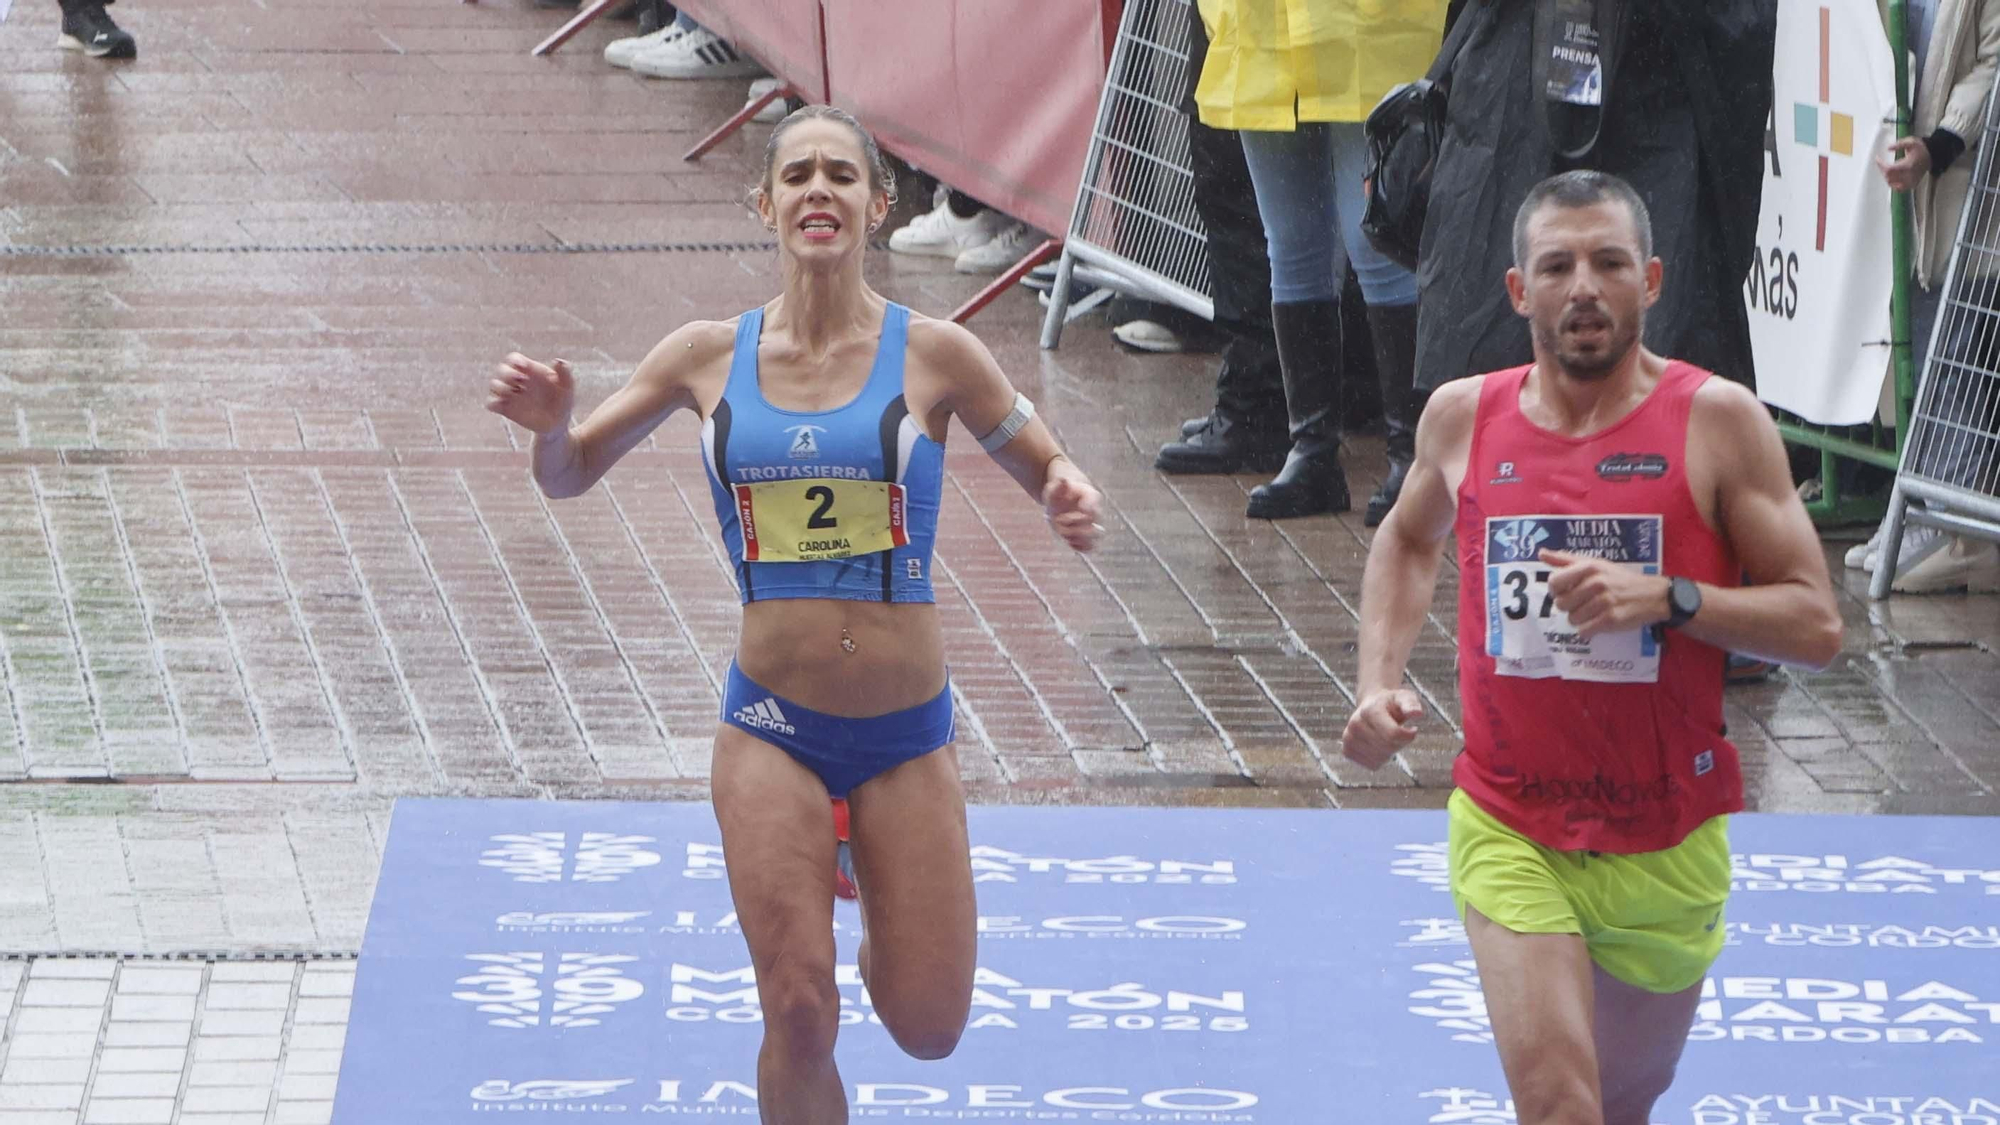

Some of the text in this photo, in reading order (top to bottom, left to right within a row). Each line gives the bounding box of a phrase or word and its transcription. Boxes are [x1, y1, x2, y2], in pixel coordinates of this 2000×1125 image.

[1552, 45, 1601, 66] PRENSA
[737, 465, 870, 480] TROTASIERRA
[805, 485, 838, 530] 2
[1566, 520, 1622, 537] MEDIA
[798, 538, 851, 552] CAROLINA
[733, 711, 796, 736] adidas
[1687, 1020, 1984, 1044] ÓRDOBA
